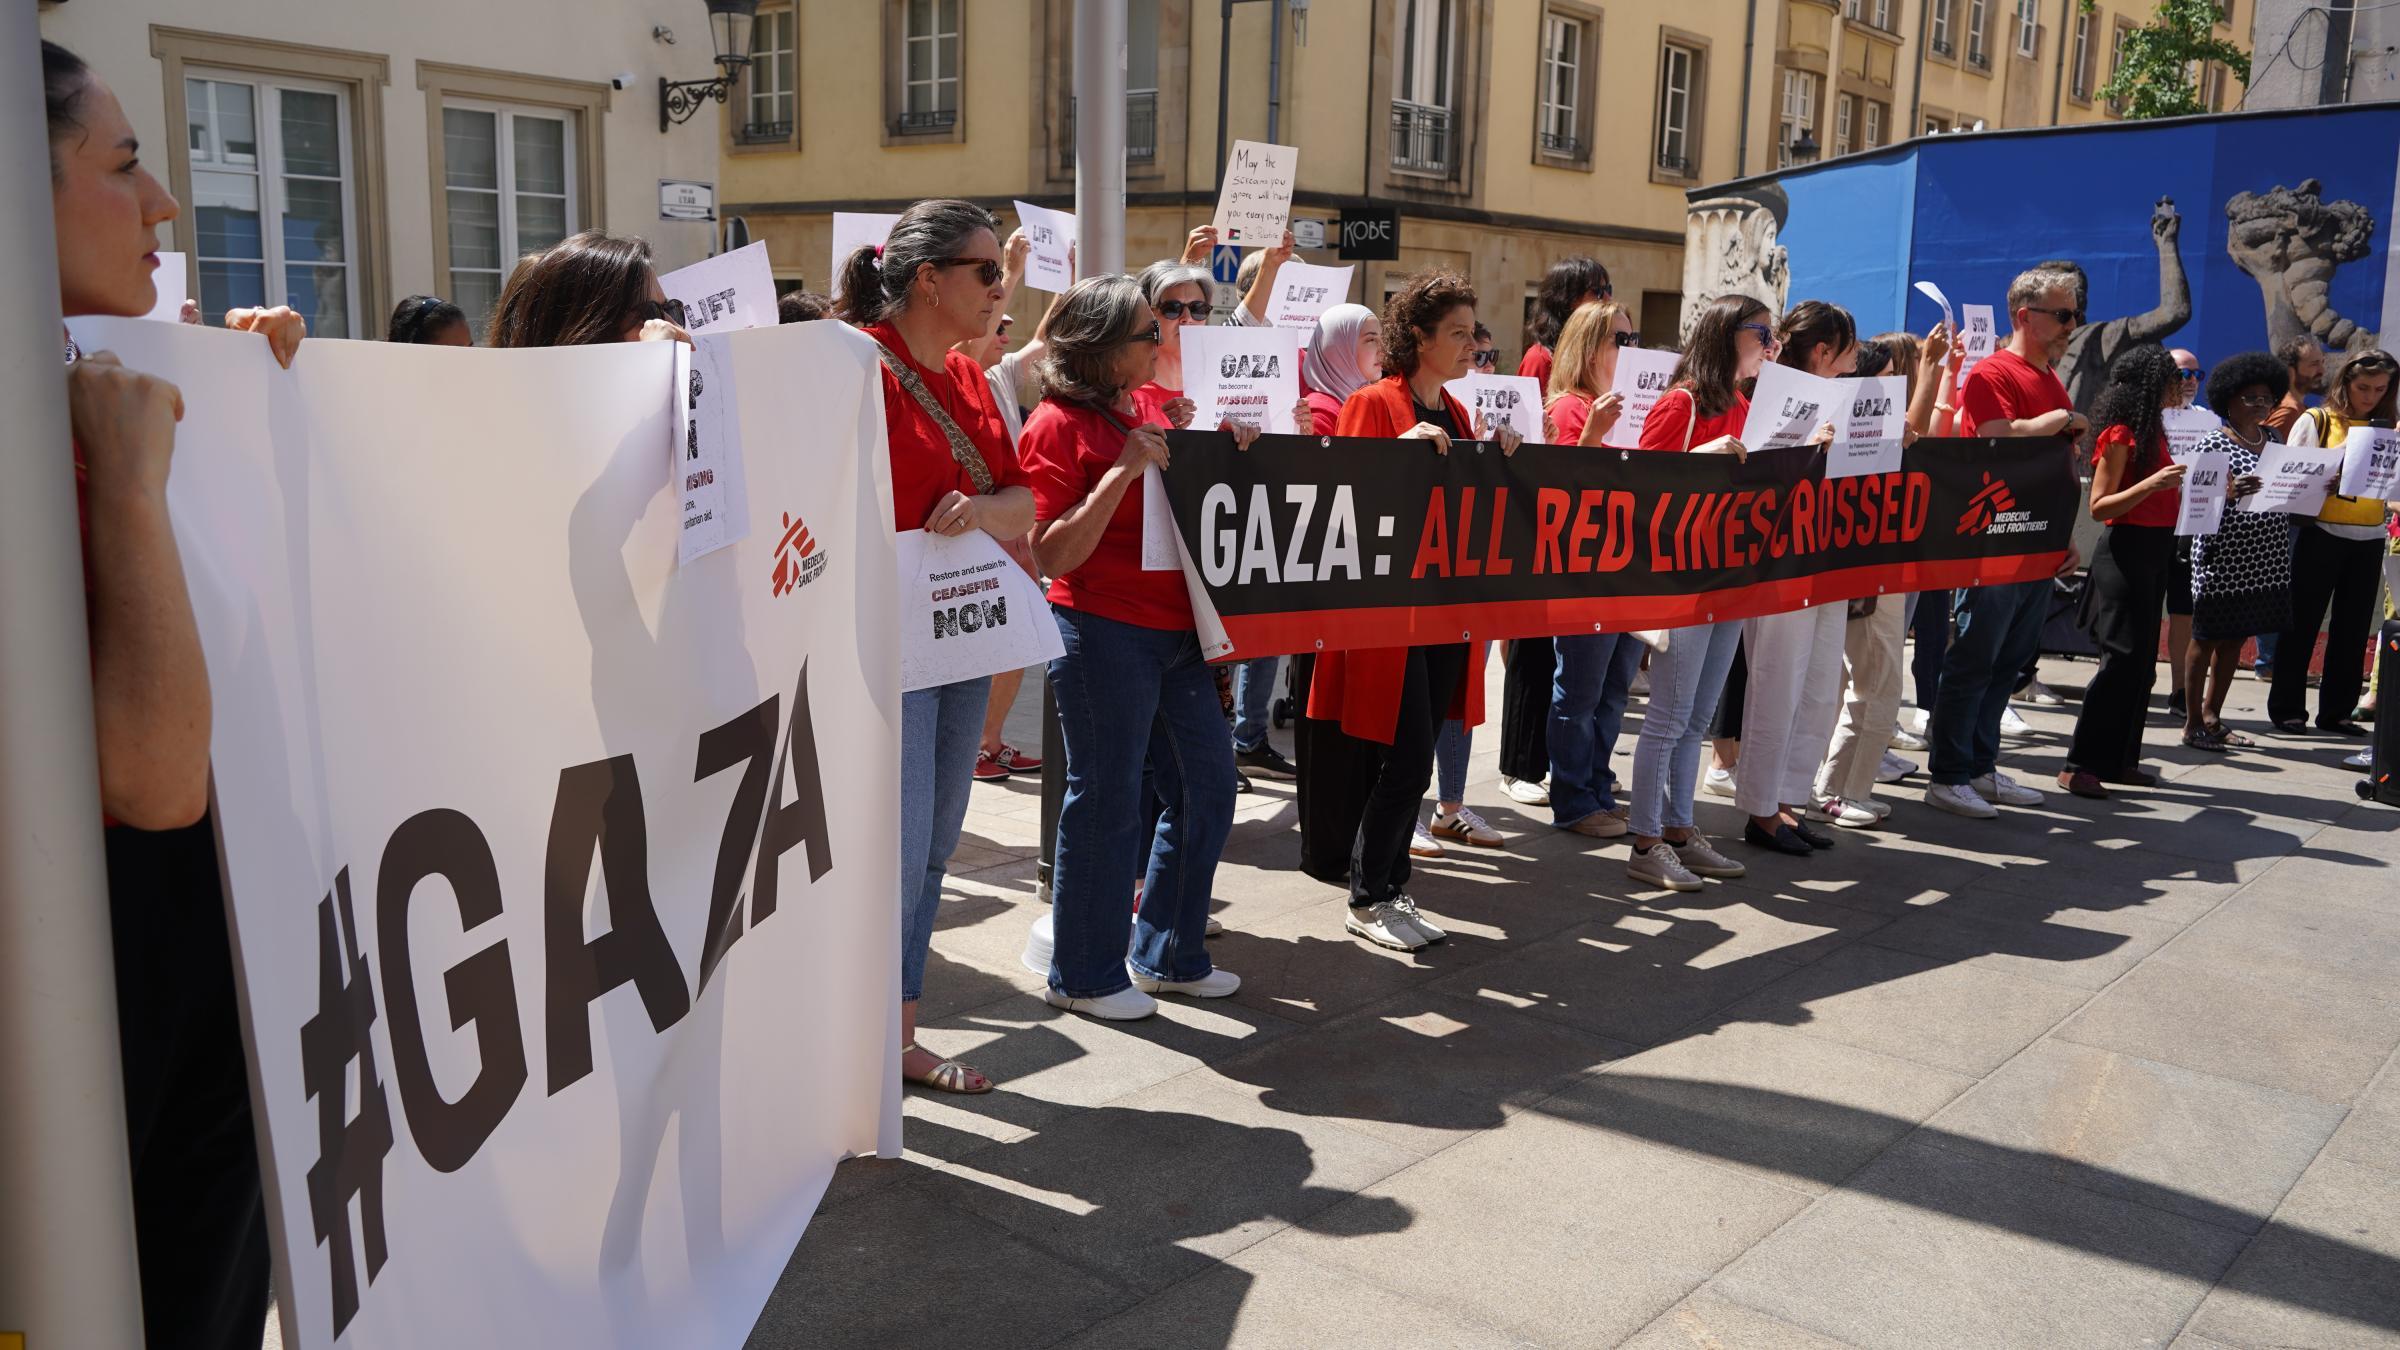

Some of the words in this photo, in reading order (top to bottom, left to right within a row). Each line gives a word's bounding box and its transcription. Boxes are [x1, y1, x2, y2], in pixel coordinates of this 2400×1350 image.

[1237, 149, 1259, 175] May
[1265, 152, 1277, 168] the
[1270, 178, 1286, 189] you
[1230, 191, 1252, 203] ignore
[1227, 209, 1241, 224] you
[1246, 211, 1265, 222] every
[1266, 212, 1287, 224] night
[1033, 224, 1053, 245] LIFT
[1343, 220, 1391, 248] KOBE
[1286, 285, 1328, 303] LIFT
[684, 288, 735, 329] LIFT
[1972, 317, 1988, 332] STOP
[1221, 354, 1281, 378] GAZA
[1217, 396, 1240, 405] MASS
[1241, 396, 1268, 405] GRAVE
[1781, 397, 1819, 420] LIFT
[1853, 398, 1892, 417] GAZA
[1484, 412, 1511, 431] OW
[2192, 470, 2218, 486] GAZA
[2281, 461, 2325, 476] GAZA
[1410, 486, 1513, 579] ALL
[1532, 487, 1635, 574] RED
[1650, 488, 1776, 573] LINES
[1770, 472, 1931, 558] CROSSED
[1995, 511, 2031, 522] MEDECINS
[1986, 524, 2006, 534] SANS
[2006, 521, 2048, 534] FRONTIERES
[799, 571, 812, 588] SANS
[929, 569, 960, 582] Restore
[961, 565, 975, 576] and
[976, 561, 998, 572] sustain
[998, 559, 1007, 568] the
[931, 577, 999, 602] CEASEFIRE
[933, 596, 1007, 639] NOW
[300, 653, 833, 1343] #GAZA
